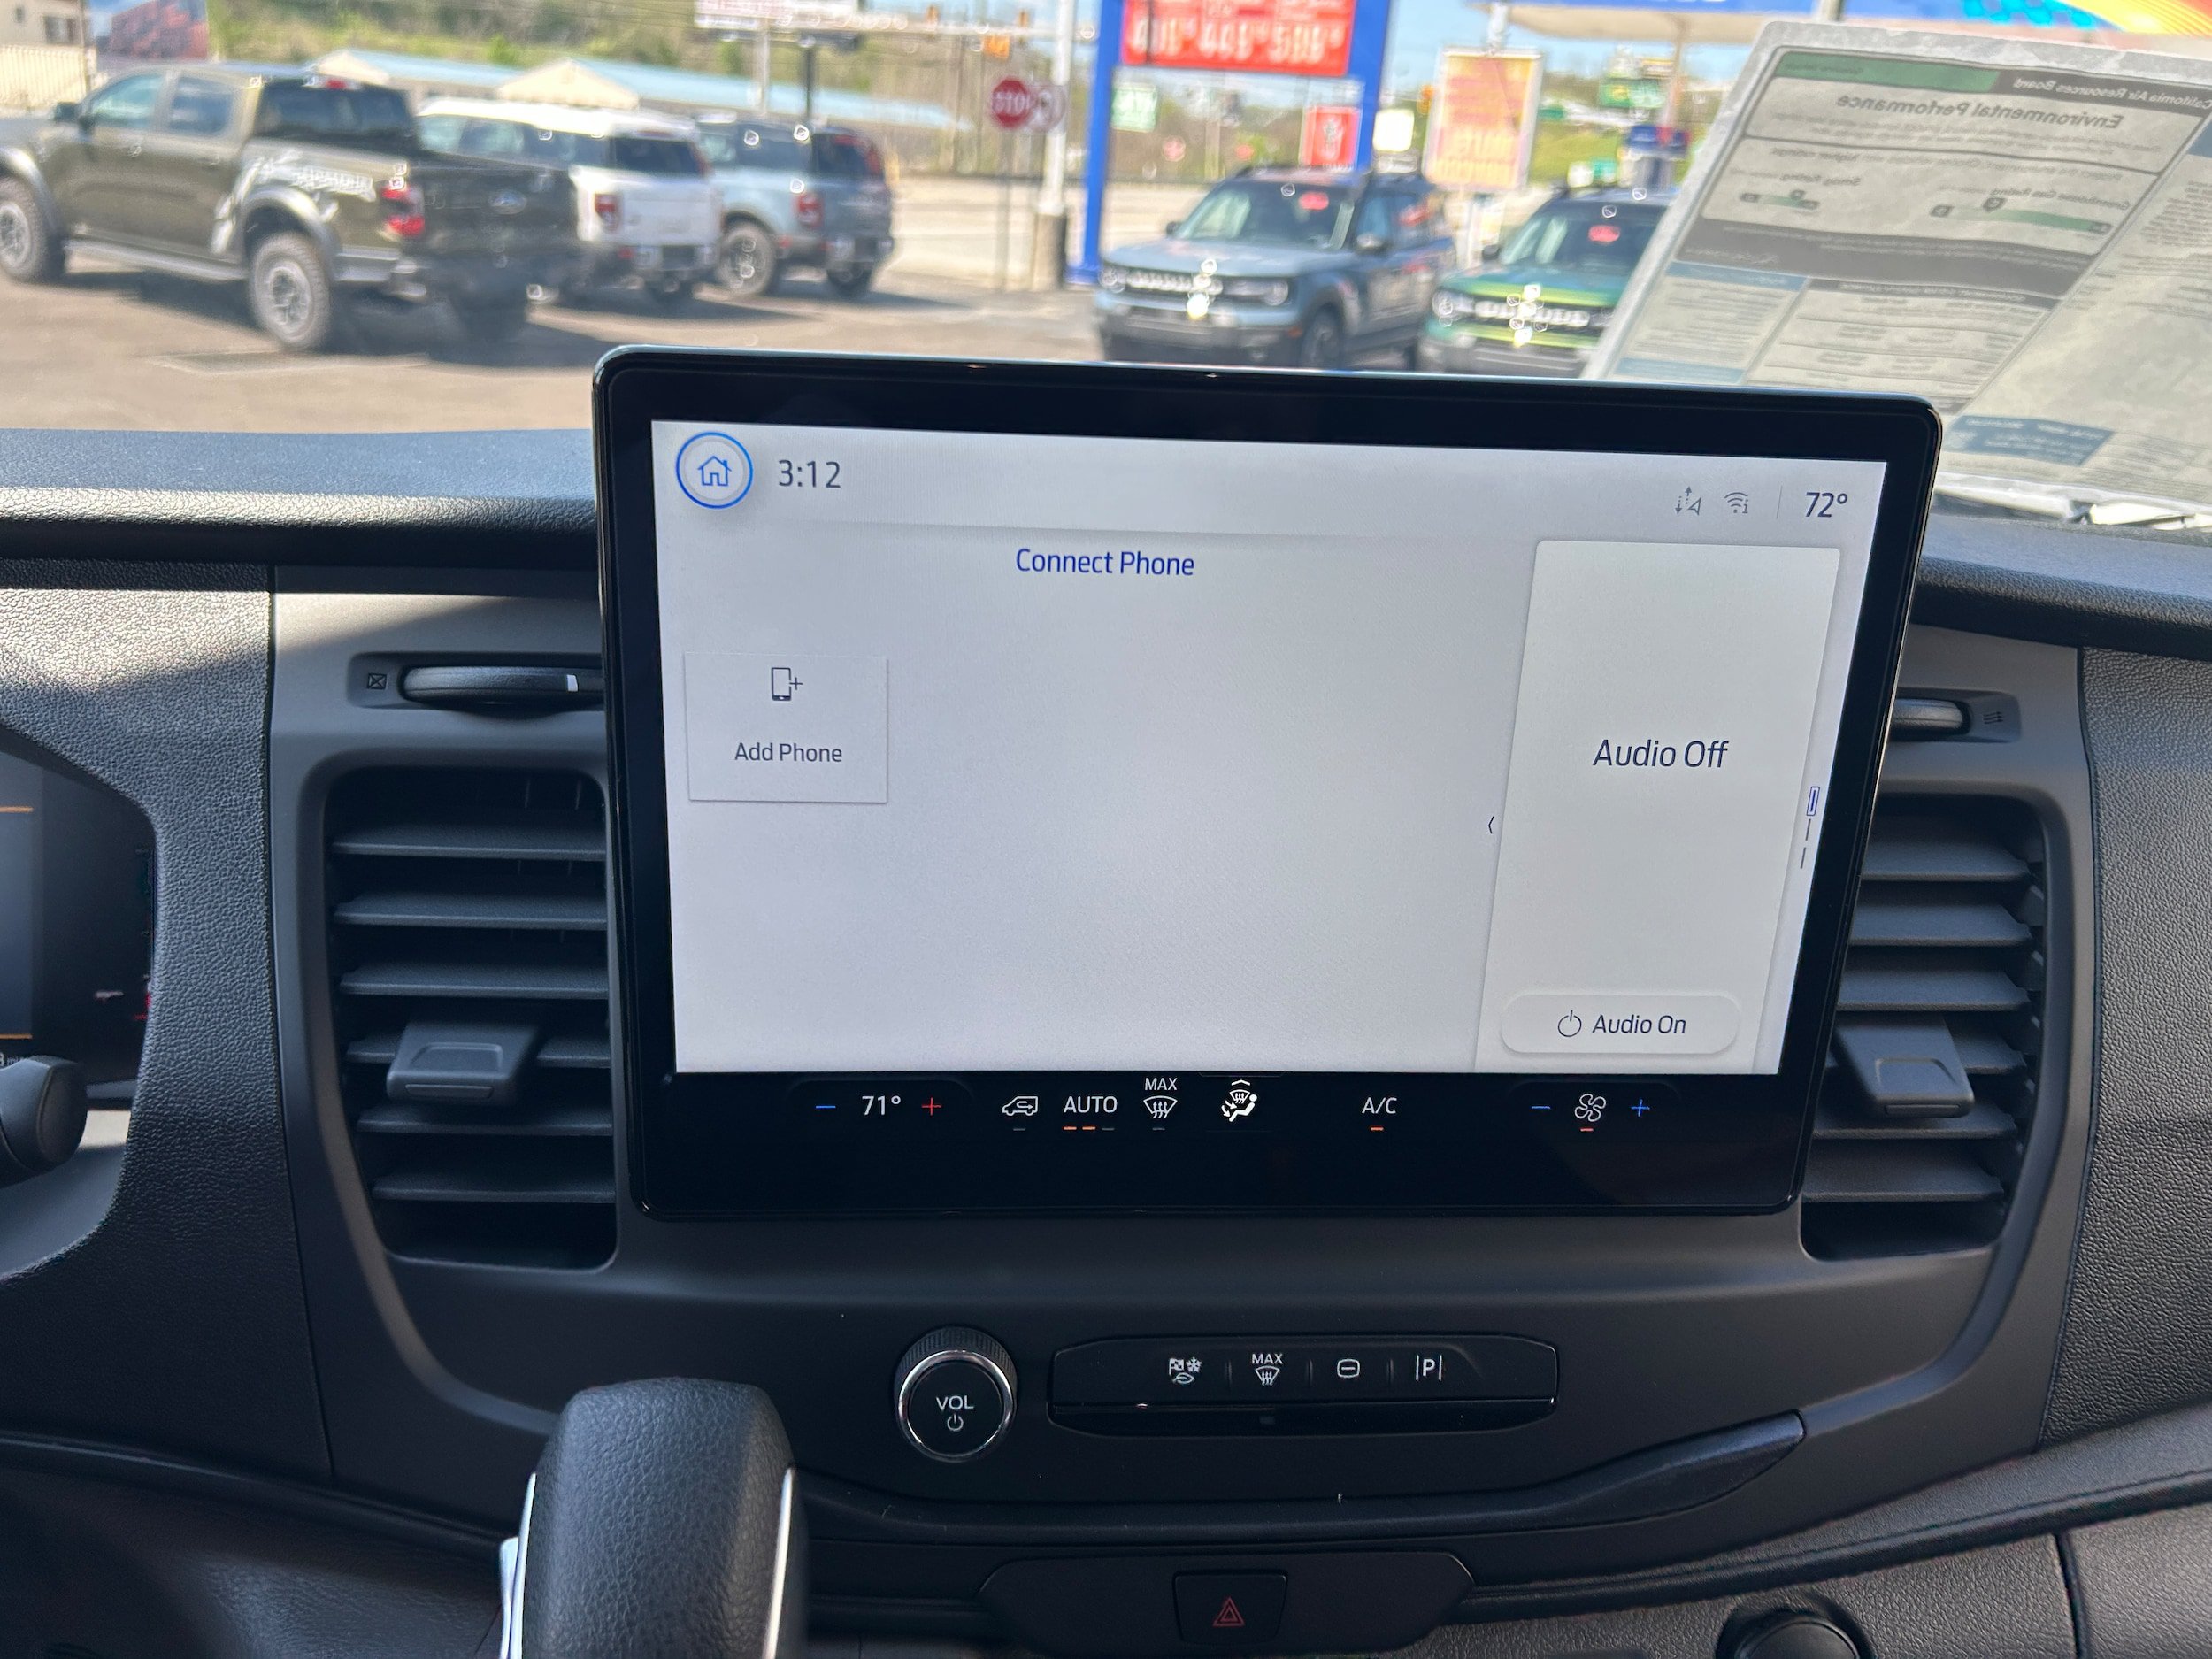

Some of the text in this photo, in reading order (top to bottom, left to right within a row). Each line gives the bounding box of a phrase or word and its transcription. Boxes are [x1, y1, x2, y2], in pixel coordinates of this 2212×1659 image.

[778, 459, 841, 490] 3:12
[1805, 490, 1849, 518] 72°
[1015, 548, 1195, 577] Connect Phone
[733, 741, 843, 764] Add Phone
[1592, 739, 1729, 769] Audio Off
[1591, 1013, 1687, 1035] Audio On
[1144, 1078, 1178, 1092] MAX
[862, 1095, 902, 1117] 71°
[1063, 1096, 1118, 1115] AUTO
[1361, 1097, 1398, 1115] A/C
[1251, 1353, 1284, 1366] MAX
[936, 1395, 975, 1412] VOL
